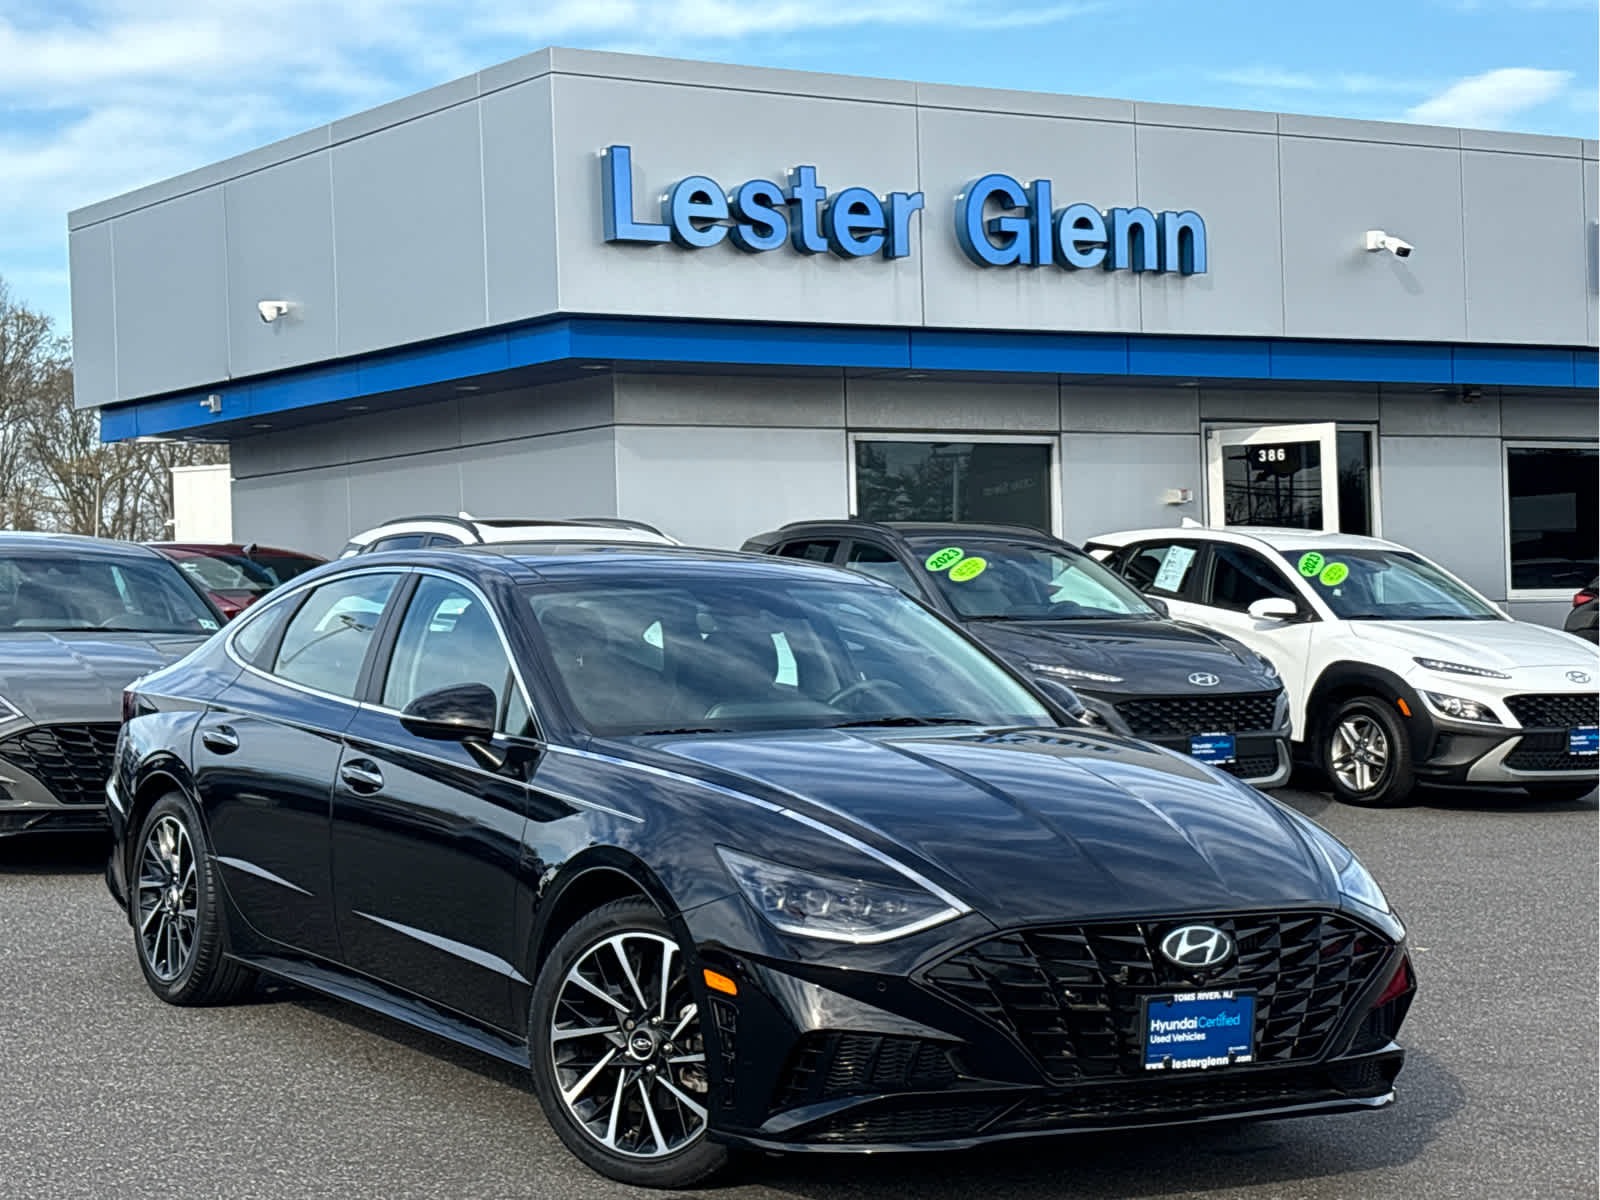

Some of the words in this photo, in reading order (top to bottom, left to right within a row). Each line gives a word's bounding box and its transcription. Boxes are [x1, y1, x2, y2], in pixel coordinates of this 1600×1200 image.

[600, 145, 924, 259] Lester
[956, 172, 1208, 275] Glenn
[1258, 448, 1286, 462] 386
[930, 548, 960, 569] 2023
[1150, 1016, 1198, 1033] Hyundai
[1198, 1011, 1241, 1029] Certified
[1150, 1034, 1171, 1044] Used
[1172, 1031, 1206, 1043] Vehicles
